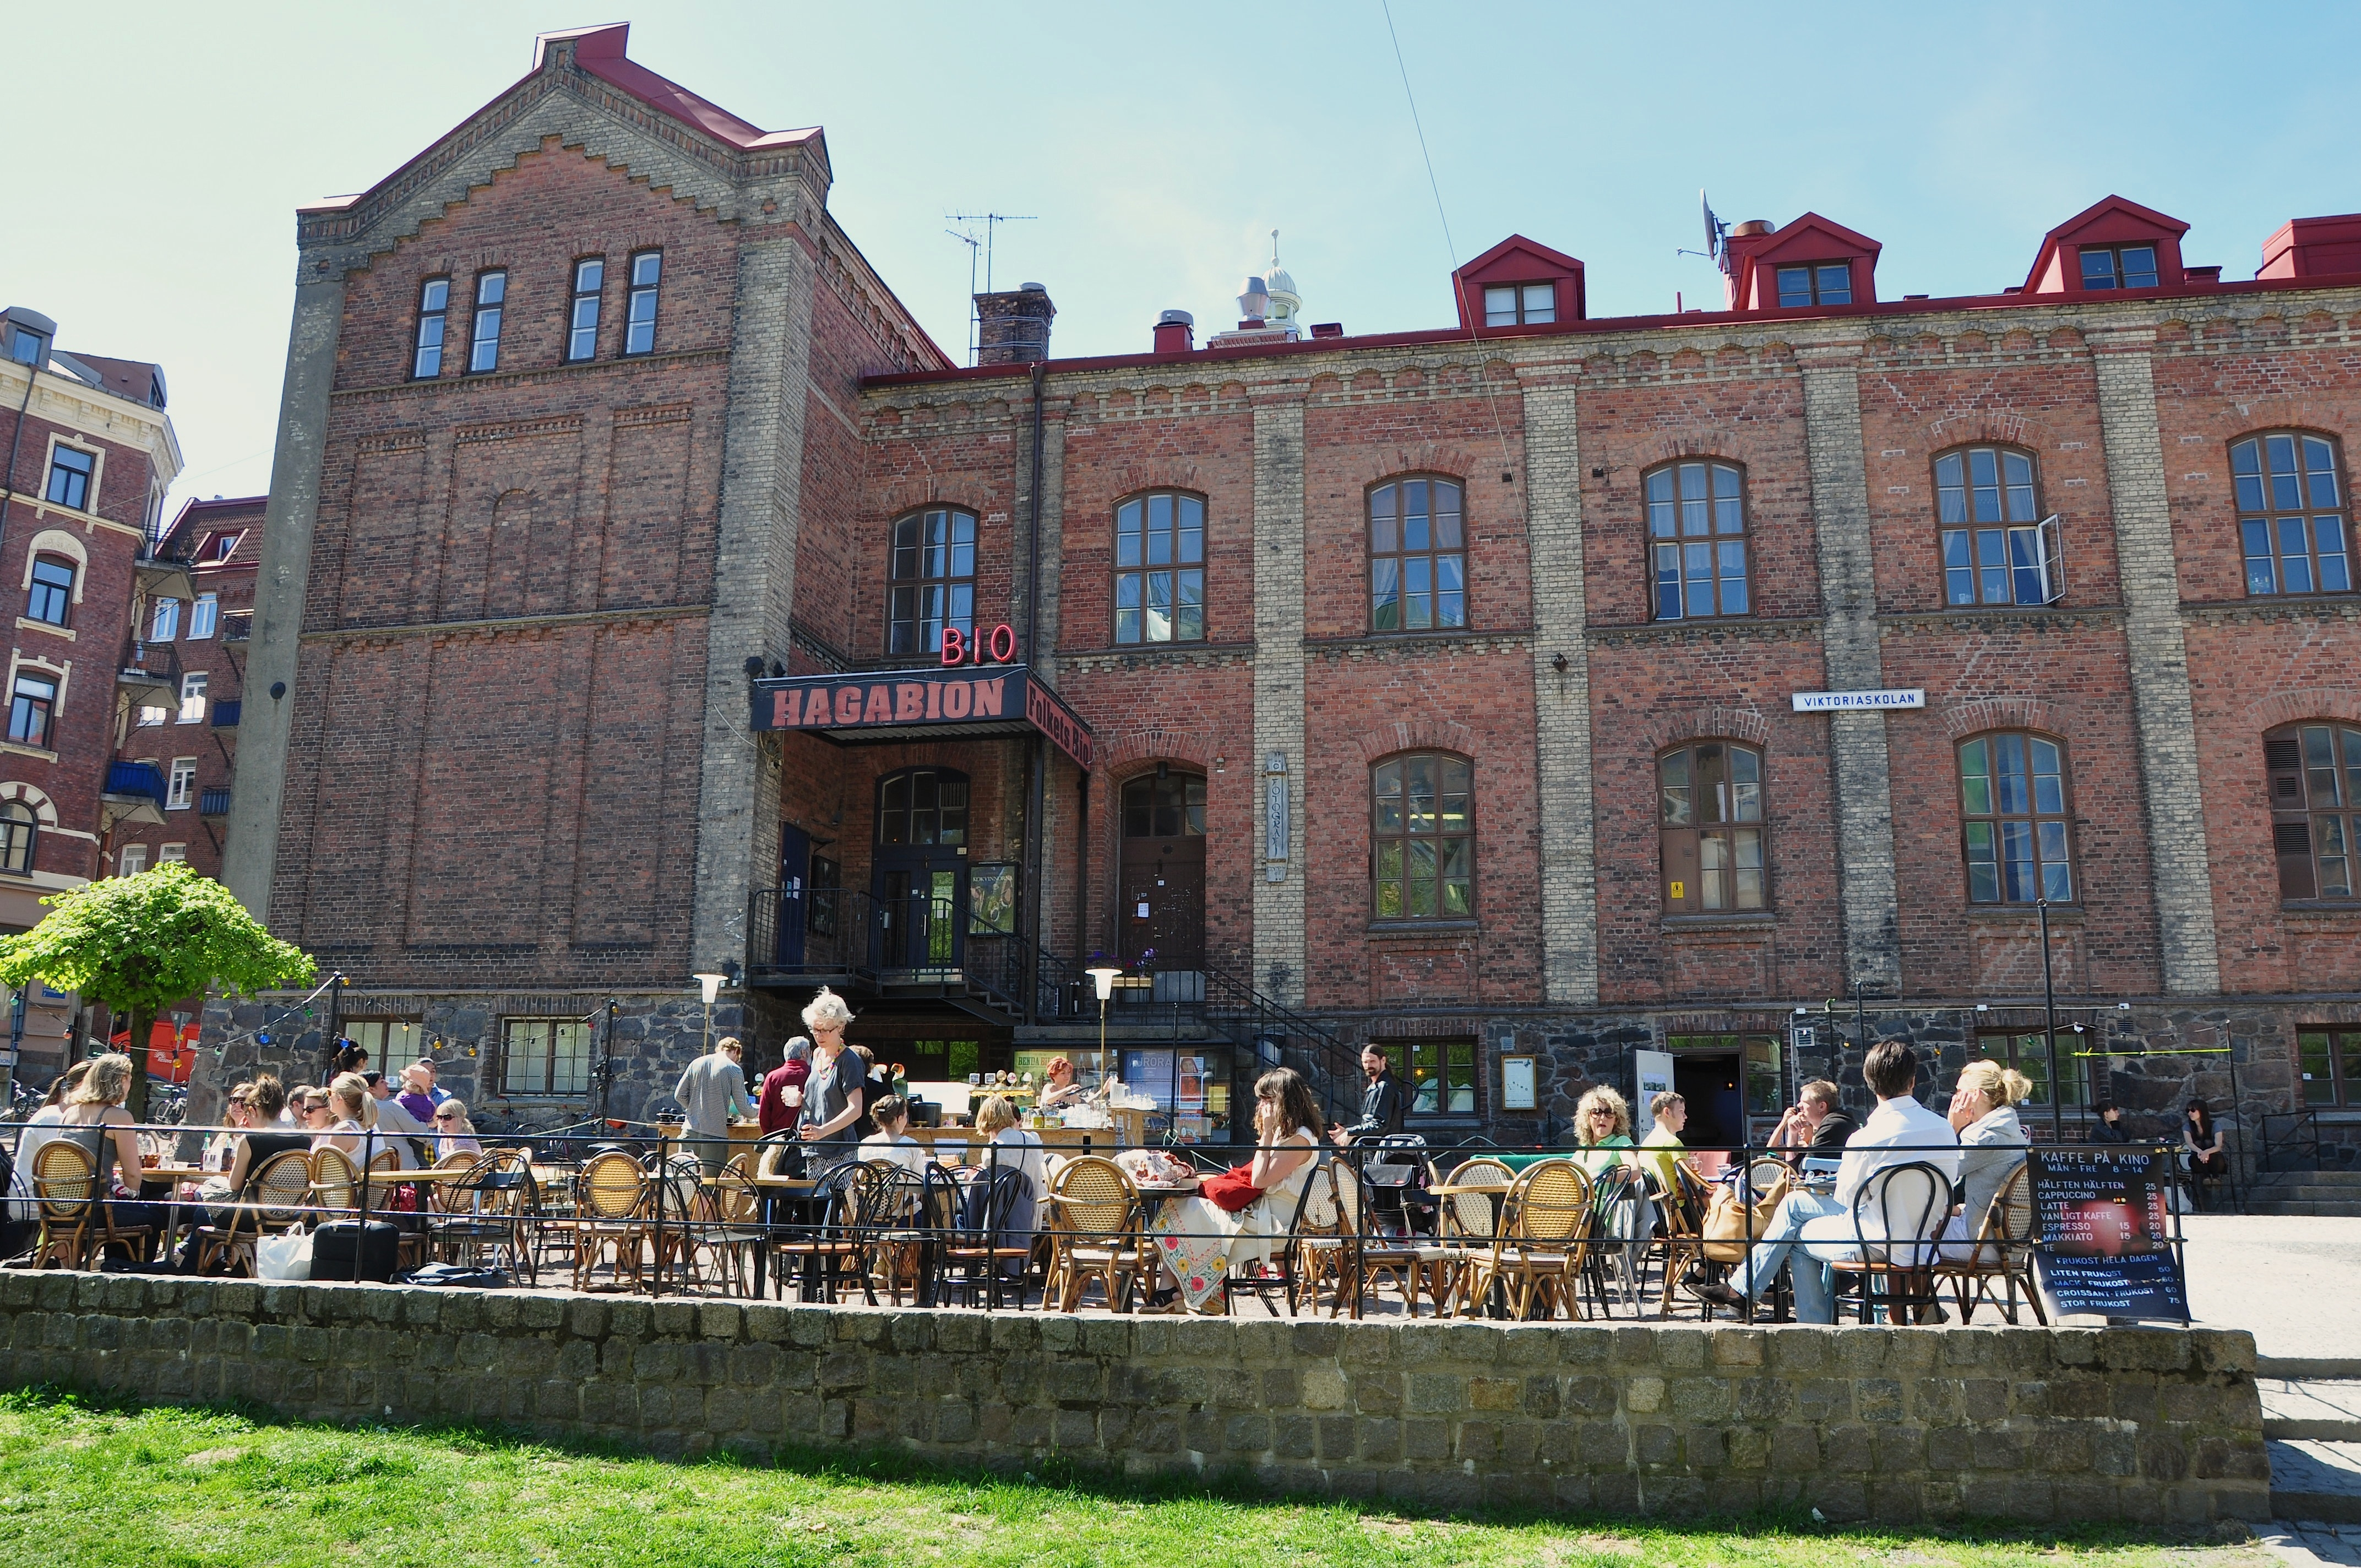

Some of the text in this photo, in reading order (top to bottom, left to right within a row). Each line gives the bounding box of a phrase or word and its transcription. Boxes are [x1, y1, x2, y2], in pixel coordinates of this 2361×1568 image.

[942, 624, 1017, 665] BIO
[772, 679, 1005, 727] HAGABION
[1804, 694, 1915, 706] VIKTORIASKOLAN
[1029, 684, 1089, 765] Folkets Bio
[1019, 1057, 1040, 1065] BENDA
[1129, 1057, 1172, 1068] AURORA
[2041, 1150, 2150, 1165] KAFFE PÅ KINO
[2048, 1163, 2069, 1172] MÅN
[2038, 1179, 2080, 1189] HÄLFTEN
[2083, 1180, 2124, 1189] HÄLFTEN
[2038, 1191, 2096, 1200] CAPPUCCINO
[2040, 1201, 2070, 1210] LATTE
[2041, 1212, 2081, 1221] VANLIGT
[2084, 1212, 2112, 1220] KAFFE
[2042, 1222, 2091, 1231] ESPRESSO
[2119, 1222, 2130, 1230] 15
[2043, 1233, 2093, 1242] MAKKIATO
[2056, 1254, 2158, 1265] FRUKOST HELA DAGEN
[2060, 1300, 2086, 1308] STOR
[2089, 1300, 2131, 1308] FRUKOST
